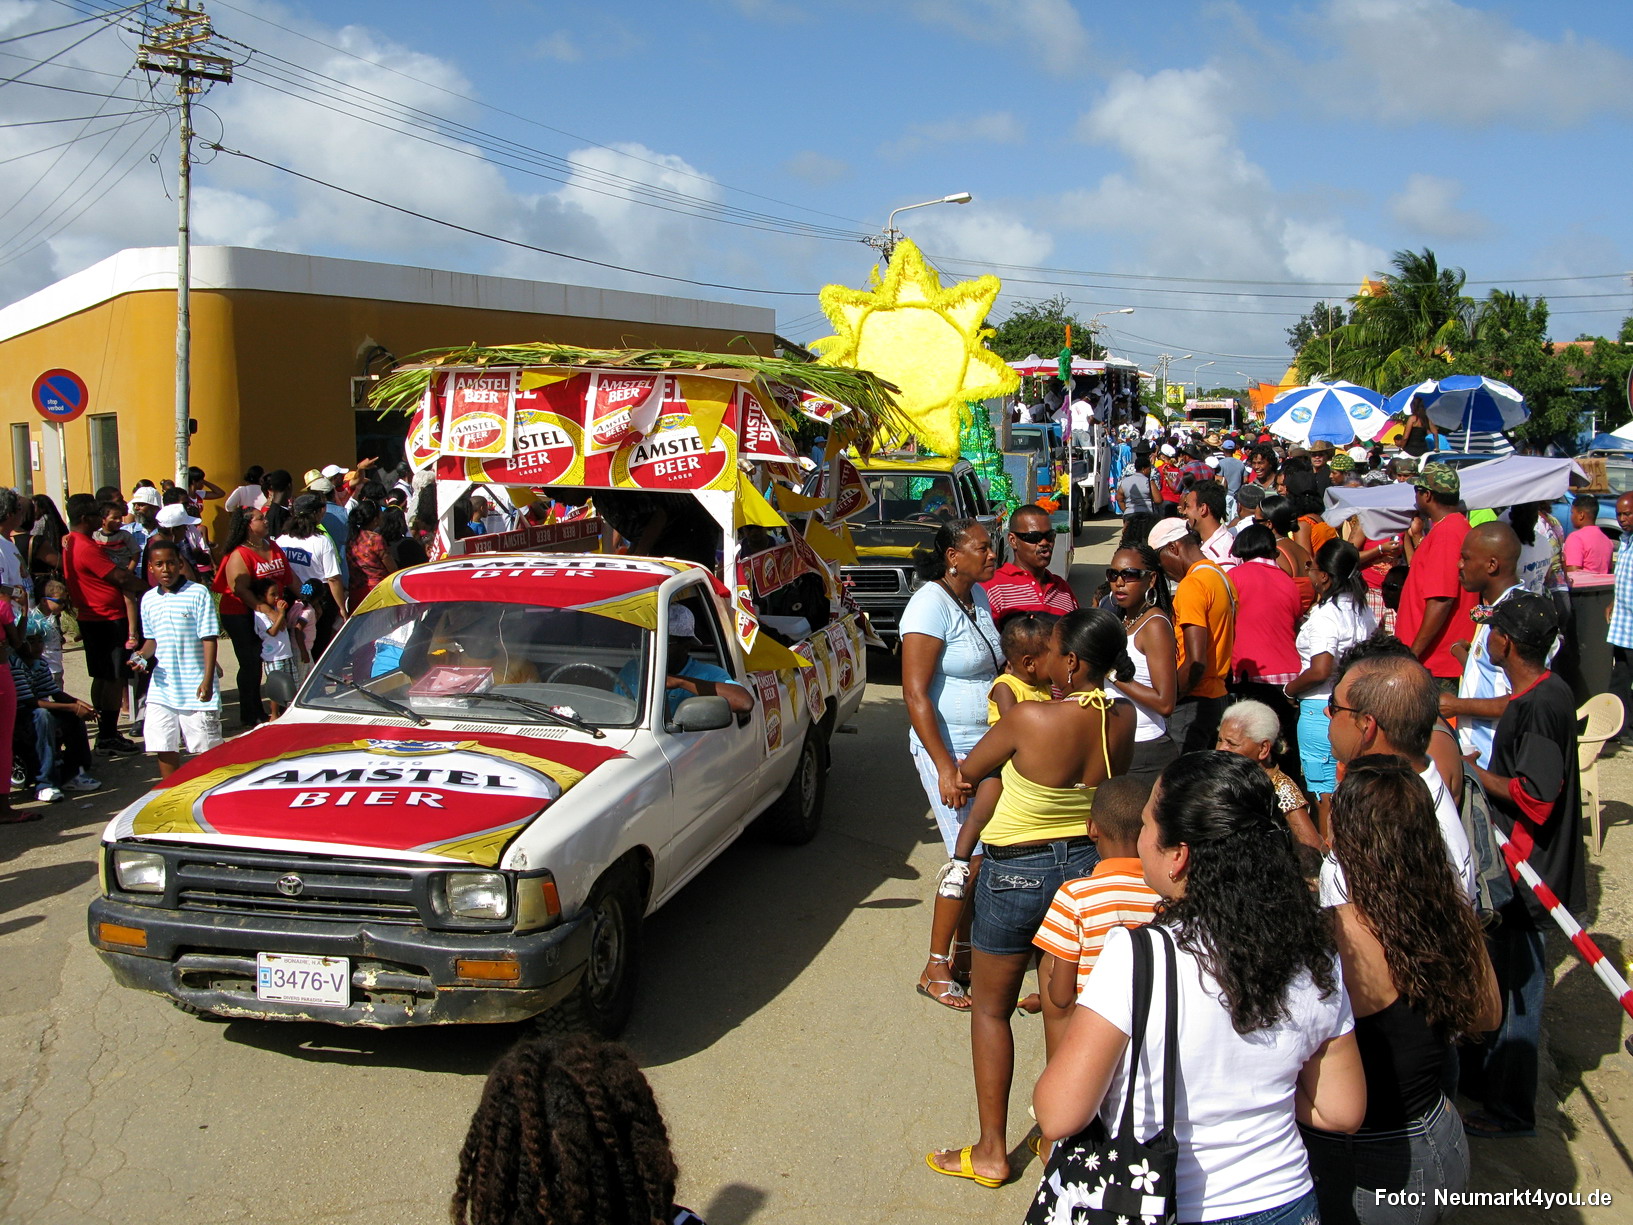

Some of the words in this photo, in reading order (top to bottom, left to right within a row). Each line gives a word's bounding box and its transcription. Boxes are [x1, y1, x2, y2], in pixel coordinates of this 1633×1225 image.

[457, 378, 509, 390] AMSTEL
[599, 379, 652, 391] AMSTEL
[463, 388, 499, 403] BEER
[608, 388, 640, 403] BEER
[455, 422, 496, 434] AMSTEL
[606, 423, 629, 438] BEER
[634, 436, 715, 463] AMSTE
[506, 451, 551, 471] BEER
[653, 456, 702, 477] BEER
[519, 467, 542, 476] LAGER
[668, 472, 693, 481] LAGER
[504, 532, 527, 549] AMSTEL
[435, 561, 652, 571] AMSTEL
[471, 569, 596, 579] BIER
[249, 768, 518, 788] AMSTEL
[288, 791, 447, 809] BIER
[274, 969, 344, 992] 3476-V
